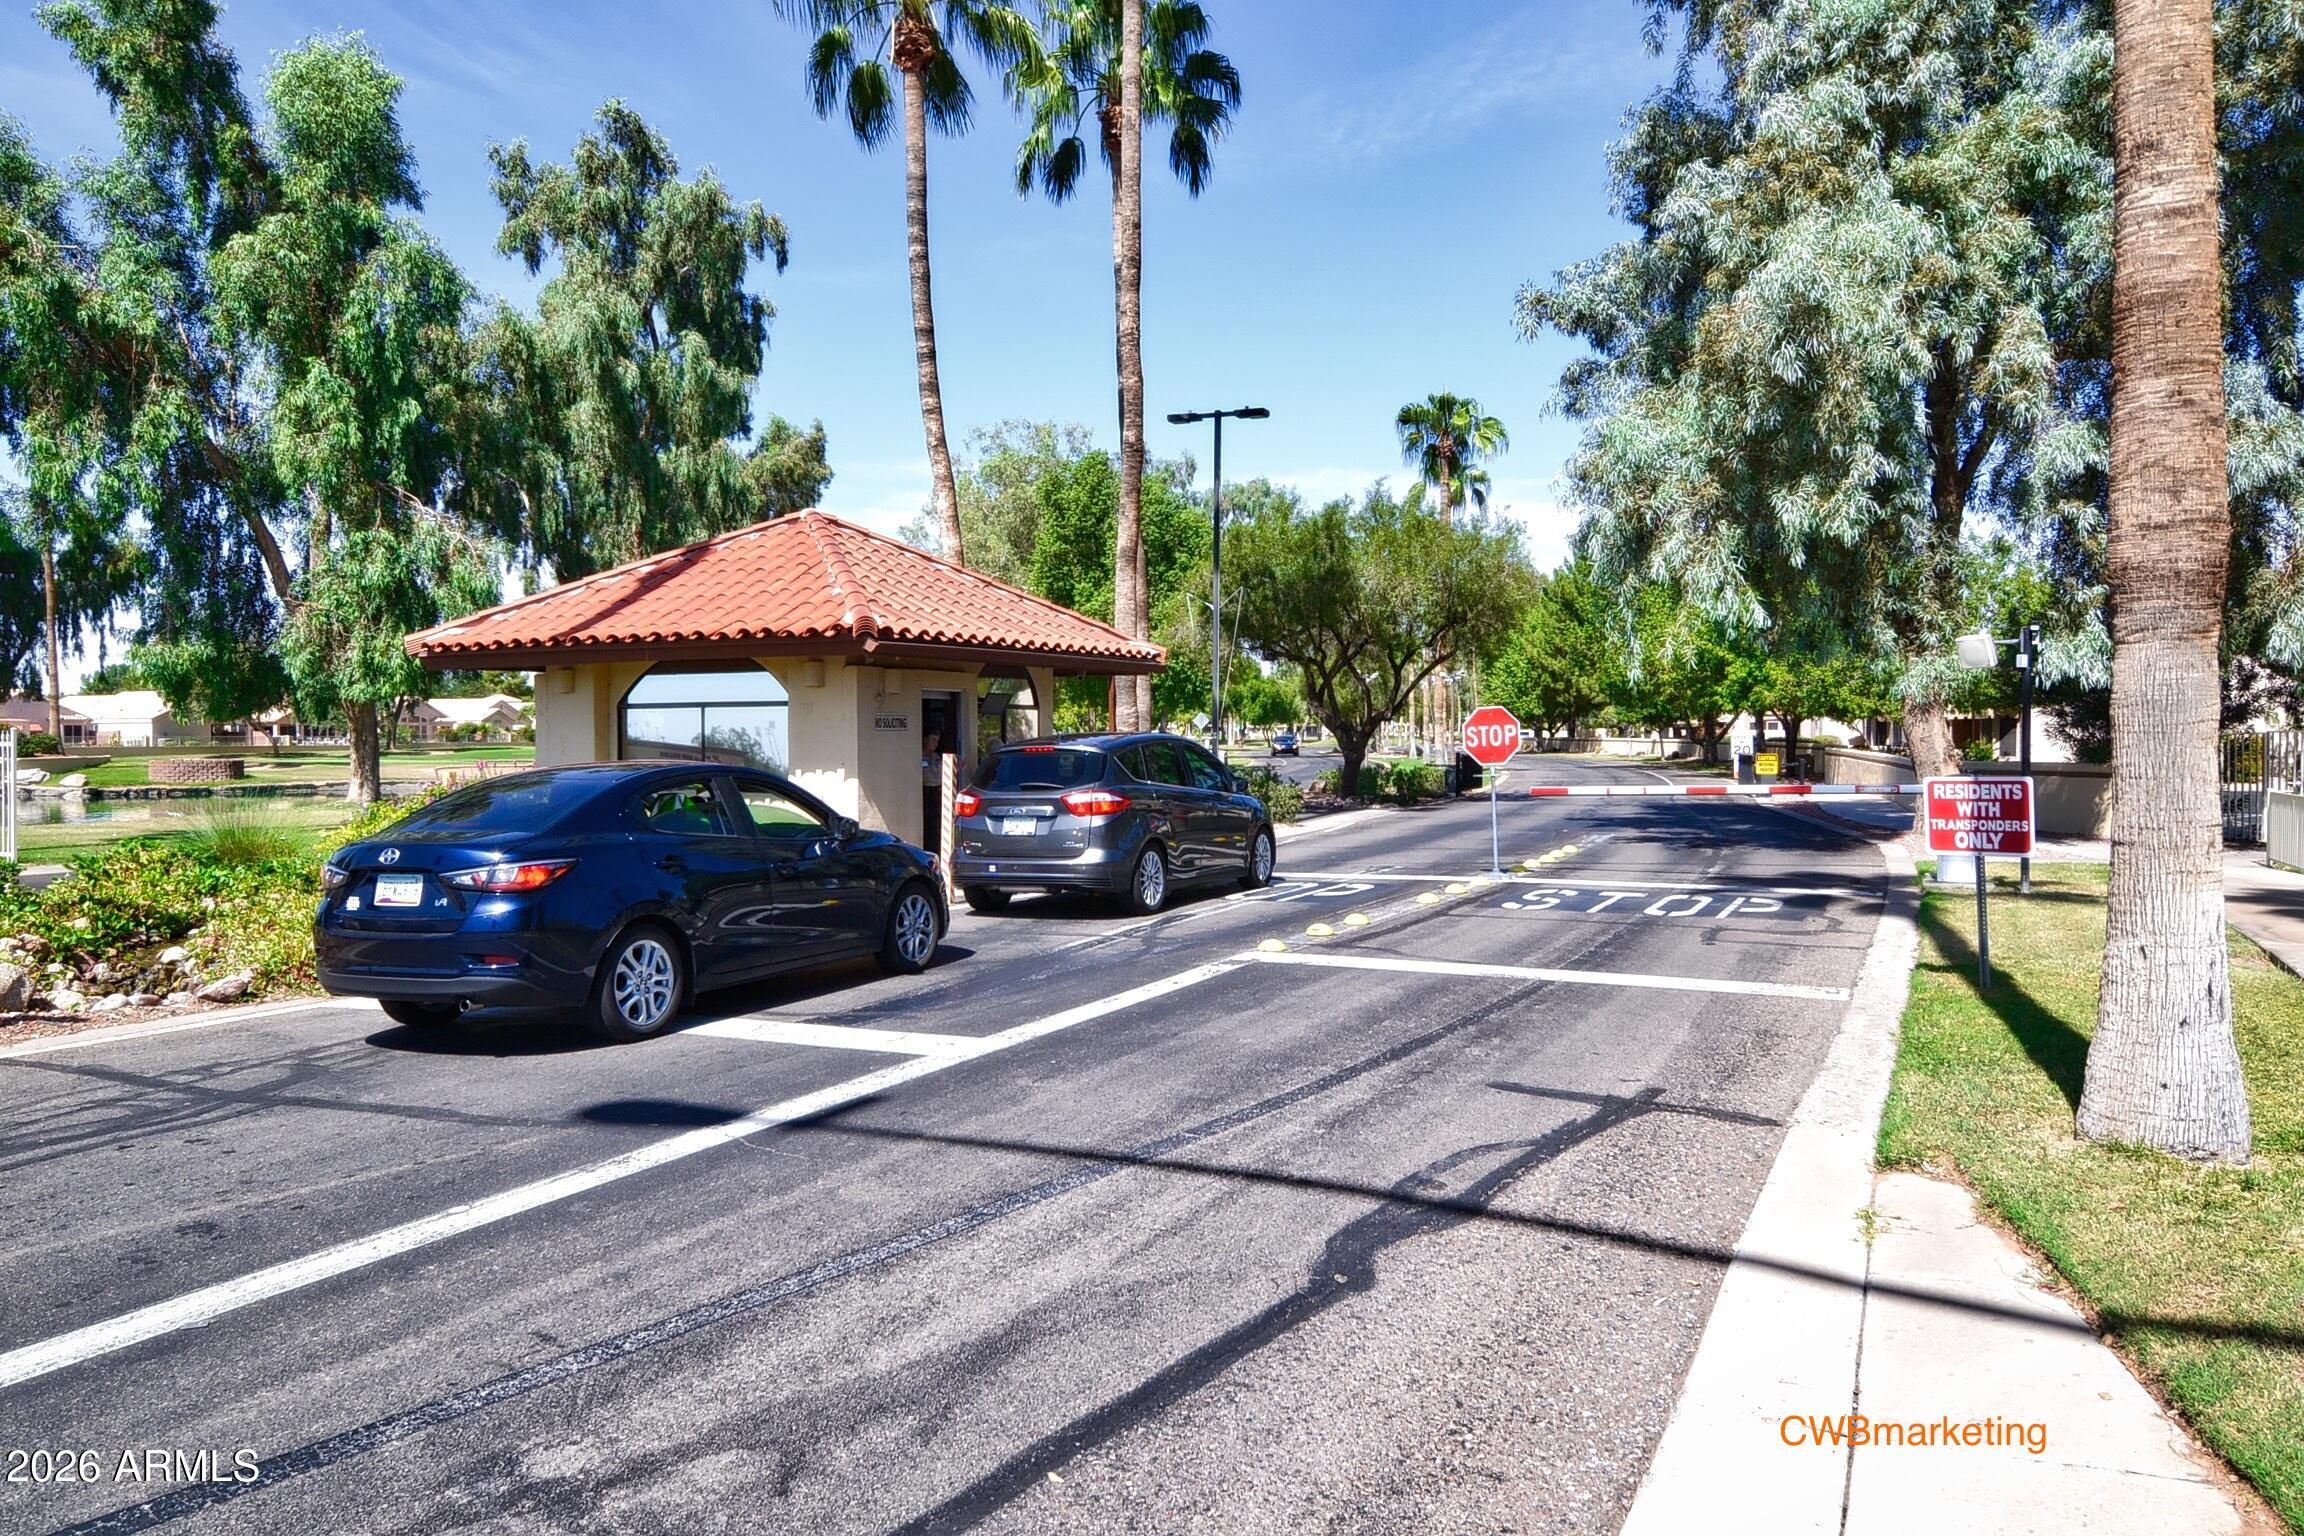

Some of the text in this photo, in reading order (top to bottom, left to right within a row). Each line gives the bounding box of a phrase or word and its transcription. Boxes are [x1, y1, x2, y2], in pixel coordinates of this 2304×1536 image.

[1466, 724, 1517, 748] STOP
[1734, 746, 1751, 755] 20
[1933, 783, 2023, 800] RESIDENTS
[1956, 802, 2001, 817] WITH
[1930, 819, 2029, 832] TRANSPONDERS
[1954, 831, 2004, 849] ONLY
[1501, 888, 1785, 919] STOP
